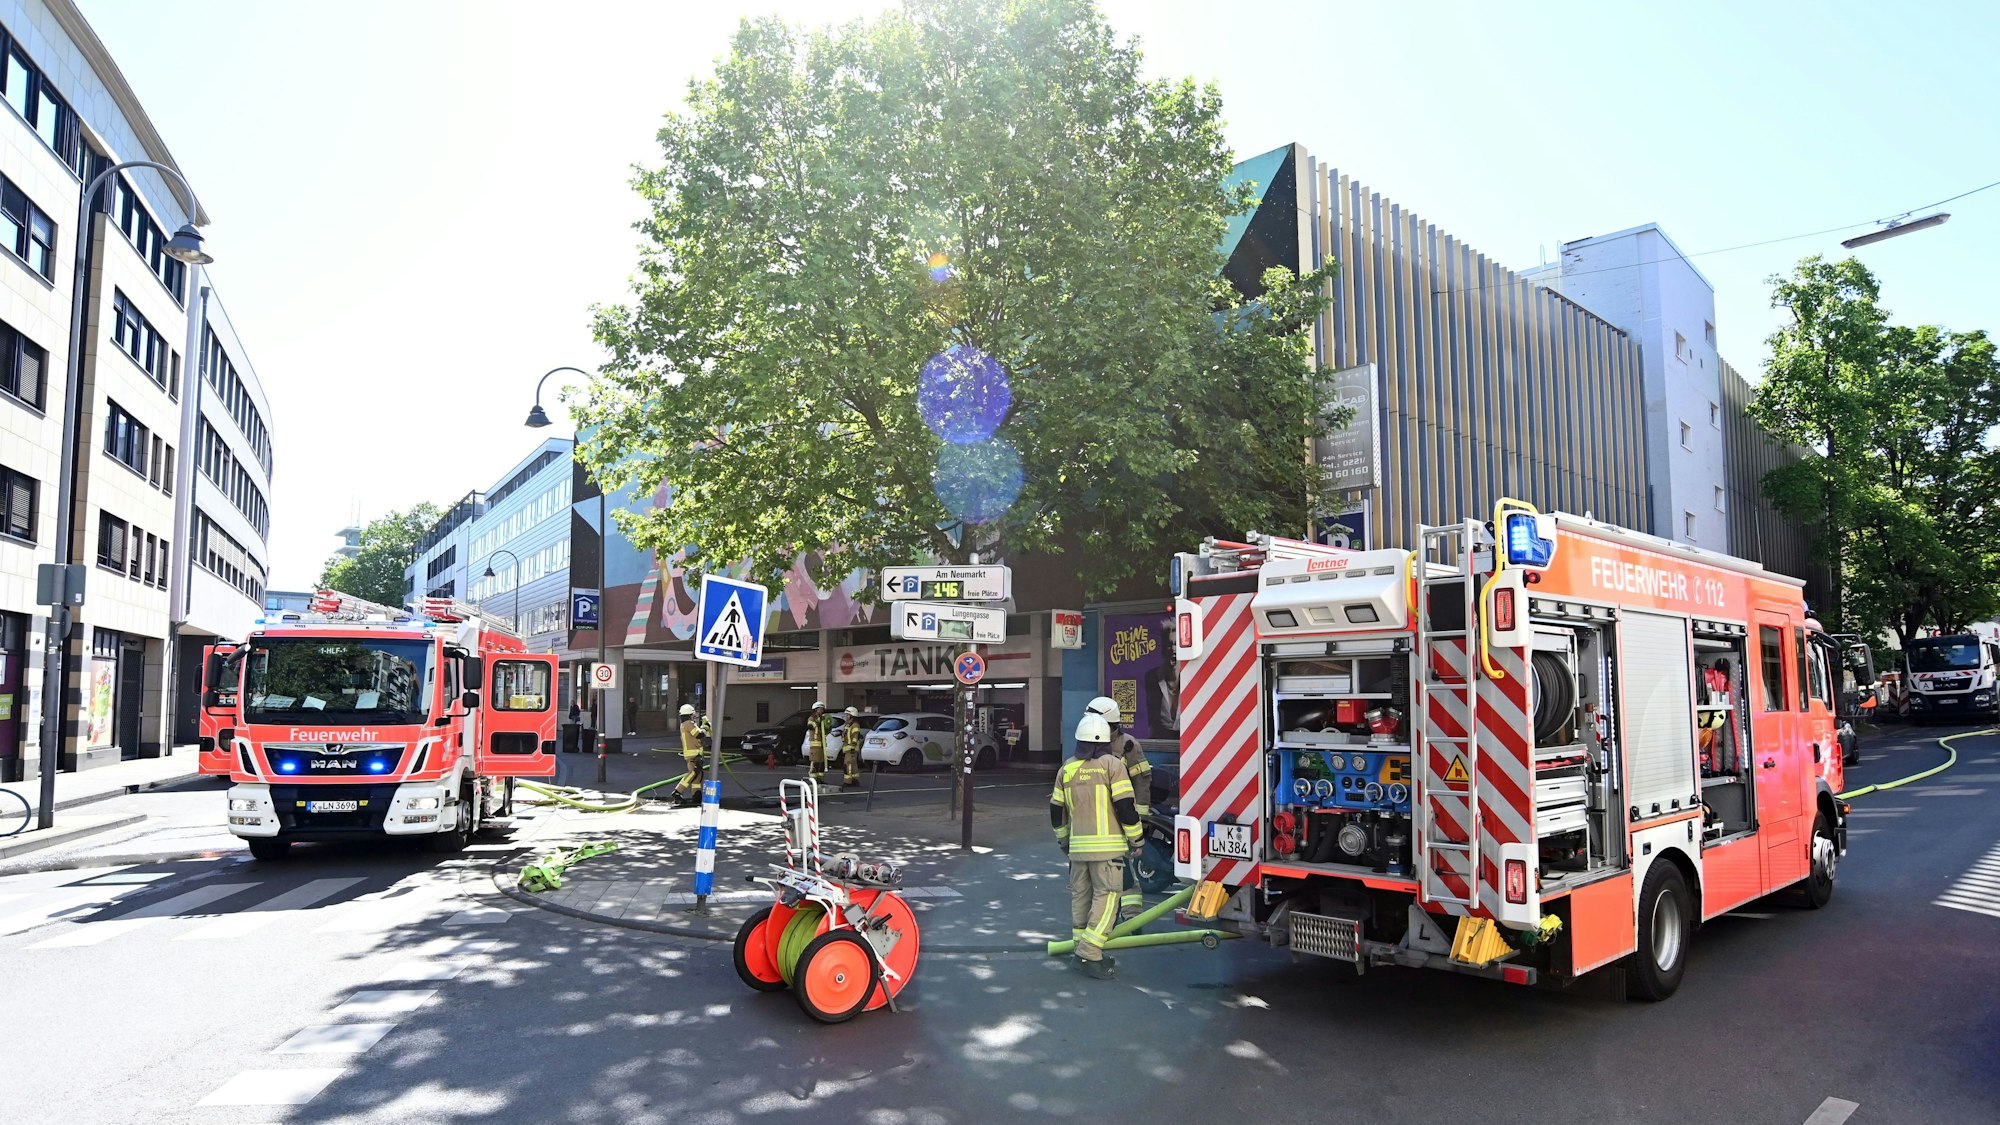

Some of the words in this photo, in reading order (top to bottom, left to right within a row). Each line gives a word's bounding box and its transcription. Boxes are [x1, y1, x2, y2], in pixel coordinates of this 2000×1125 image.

[1330, 438, 1356, 447] Service
[1337, 450, 1363, 459] Service
[1342, 457, 1366, 467] 0221/
[1335, 470, 1348, 478] 60
[1351, 466, 1369, 476] 160
[1307, 558, 1349, 572] Lentner
[936, 571, 948, 579] Am
[951, 571, 986, 579] Neumarkt
[1591, 556, 1688, 601] FEUERWEHR
[1705, 579, 1725, 607] 112
[934, 582, 958, 598] 146
[982, 589, 998, 597] Plätze
[952, 609, 989, 620] Lungengasse
[875, 645, 955, 677] TANK
[600, 670, 608, 678] 30
[290, 727, 379, 741] Feuerwehr
[311, 760, 357, 768] MAN
[1227, 827, 1234, 840] K
[1212, 839, 1226, 852] LN
[1228, 841, 1247, 855] 384
